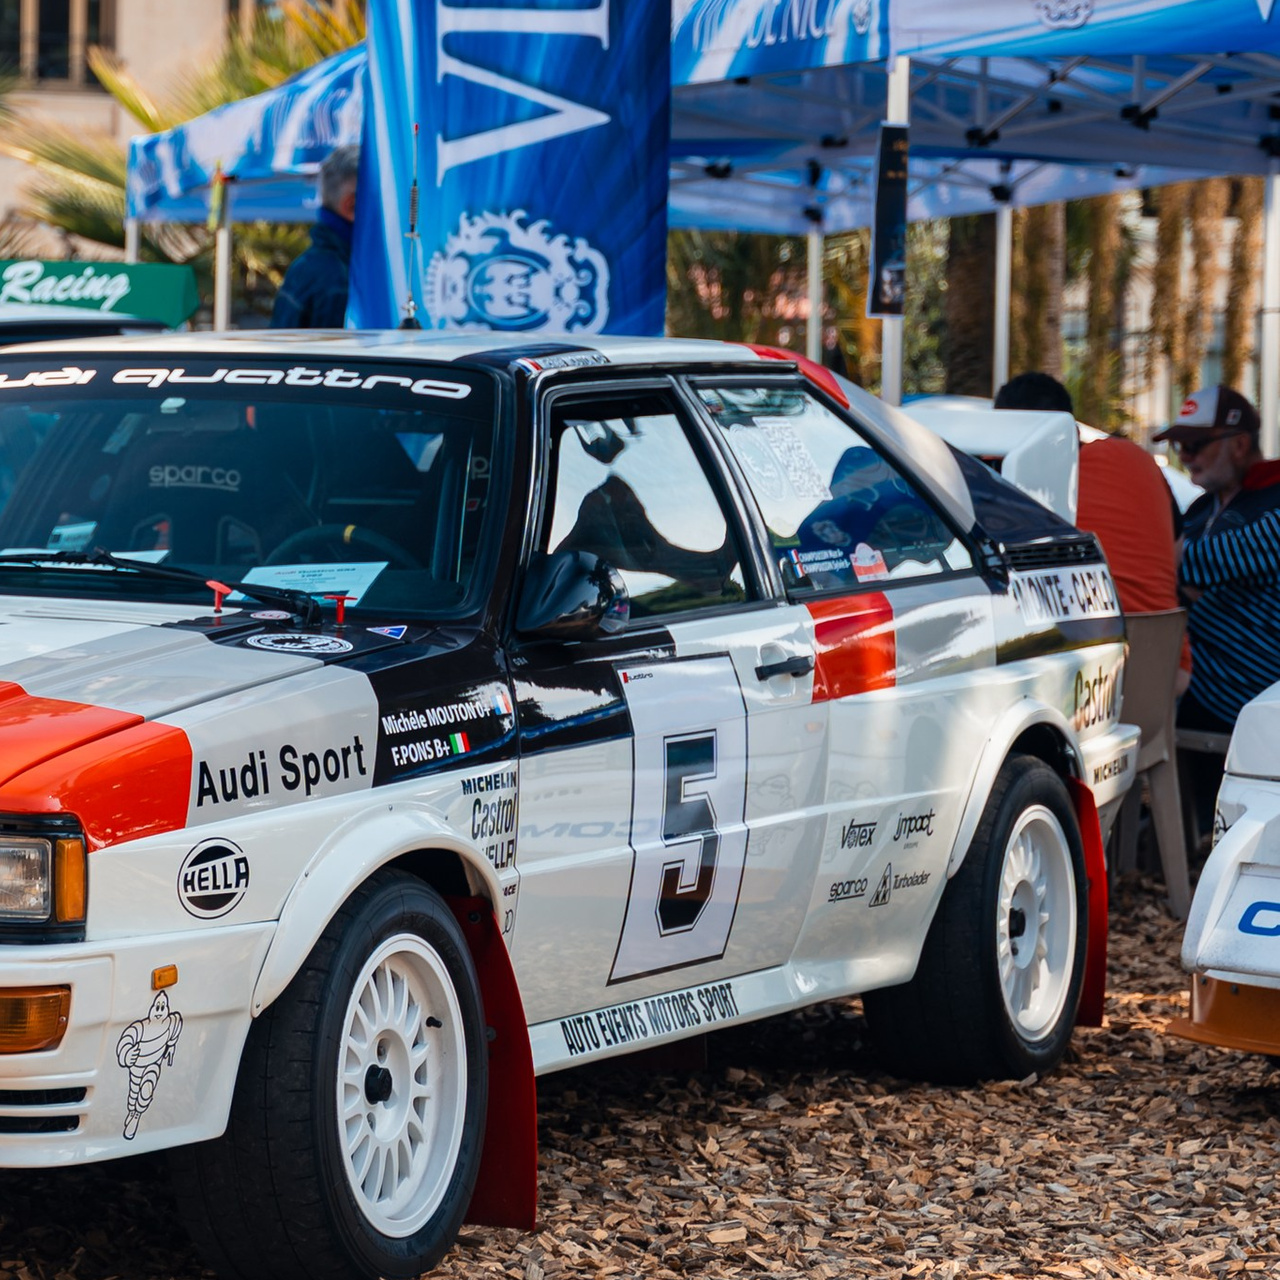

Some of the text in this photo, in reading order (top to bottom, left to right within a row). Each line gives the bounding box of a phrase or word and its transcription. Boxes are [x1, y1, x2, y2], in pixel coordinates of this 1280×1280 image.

[112, 367, 472, 400] quattro
[149, 464, 241, 488] sparco
[428, 702, 476, 729] MOUTON
[391, 738, 451, 767] F.PONS B+
[196, 735, 368, 808] Audi Sport
[461, 771, 517, 796] MICHELIN
[471, 793, 518, 841] Castrol
[655, 728, 721, 937] 5
[482, 839, 516, 870] ELLA
[182, 857, 251, 895] HELLA
[829, 877, 869, 903] sparco
[560, 982, 740, 1056] AUTO EVENTS MOTORS SPORT
